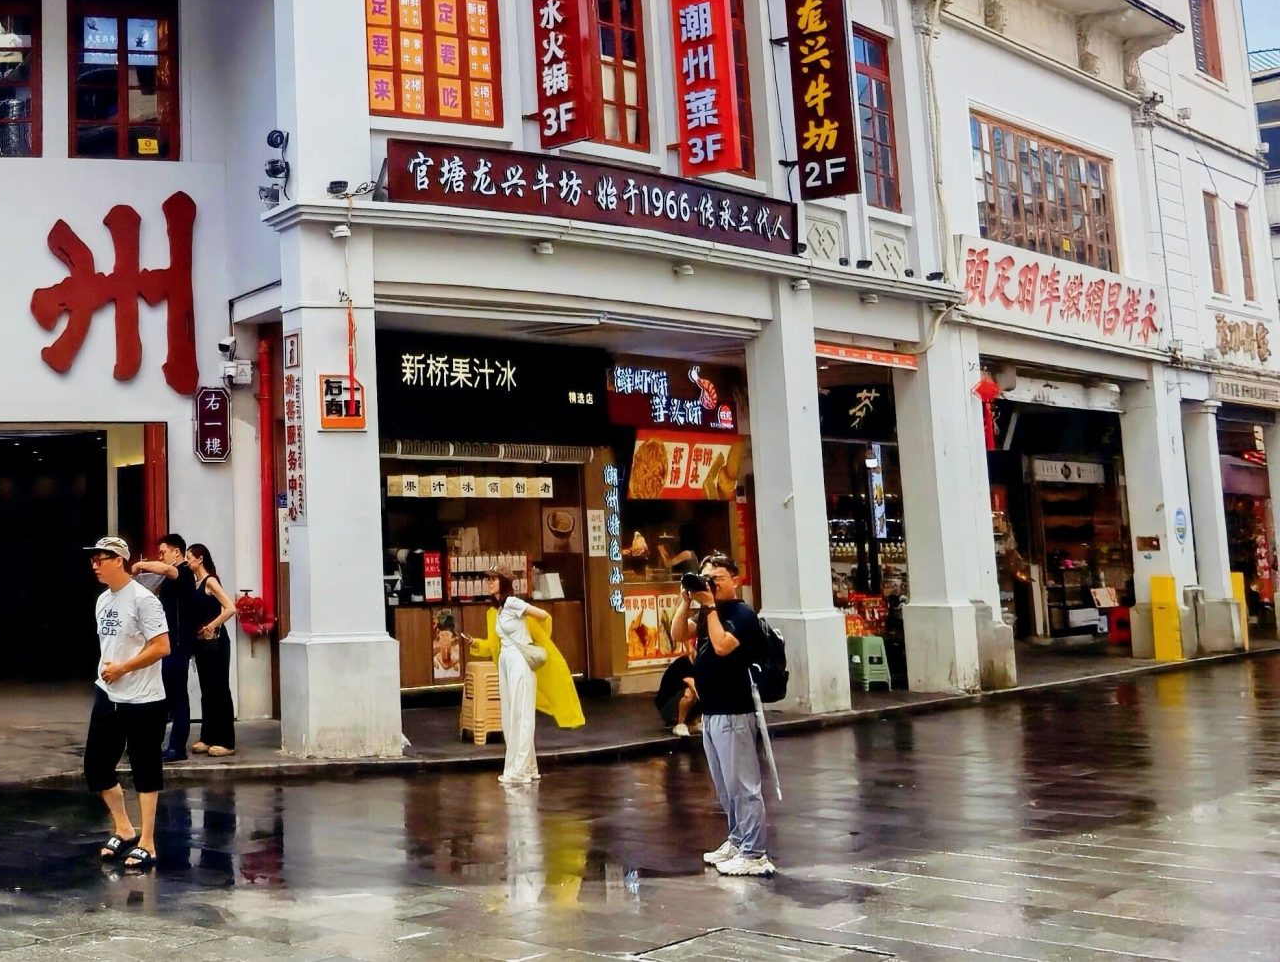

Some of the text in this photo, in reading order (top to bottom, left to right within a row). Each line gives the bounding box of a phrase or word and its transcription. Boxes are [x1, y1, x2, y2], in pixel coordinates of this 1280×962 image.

[679, 1, 718, 129] 潮州菜
[542, 102, 574, 136] 3F
[688, 133, 721, 165] 3F
[805, 156, 846, 187] 2F
[401, 353, 517, 392] 新桥果汁冰
[614, 366, 668, 396] 鲜虾饼
[568, 392, 594, 405] 精选店
[651, 395, 702, 425] 芋头饼
[204, 393, 222, 455] 右一樓
[404, 481, 552, 495] 果汁冰领创者
[604, 463, 625, 613] 潮州特色小吃
